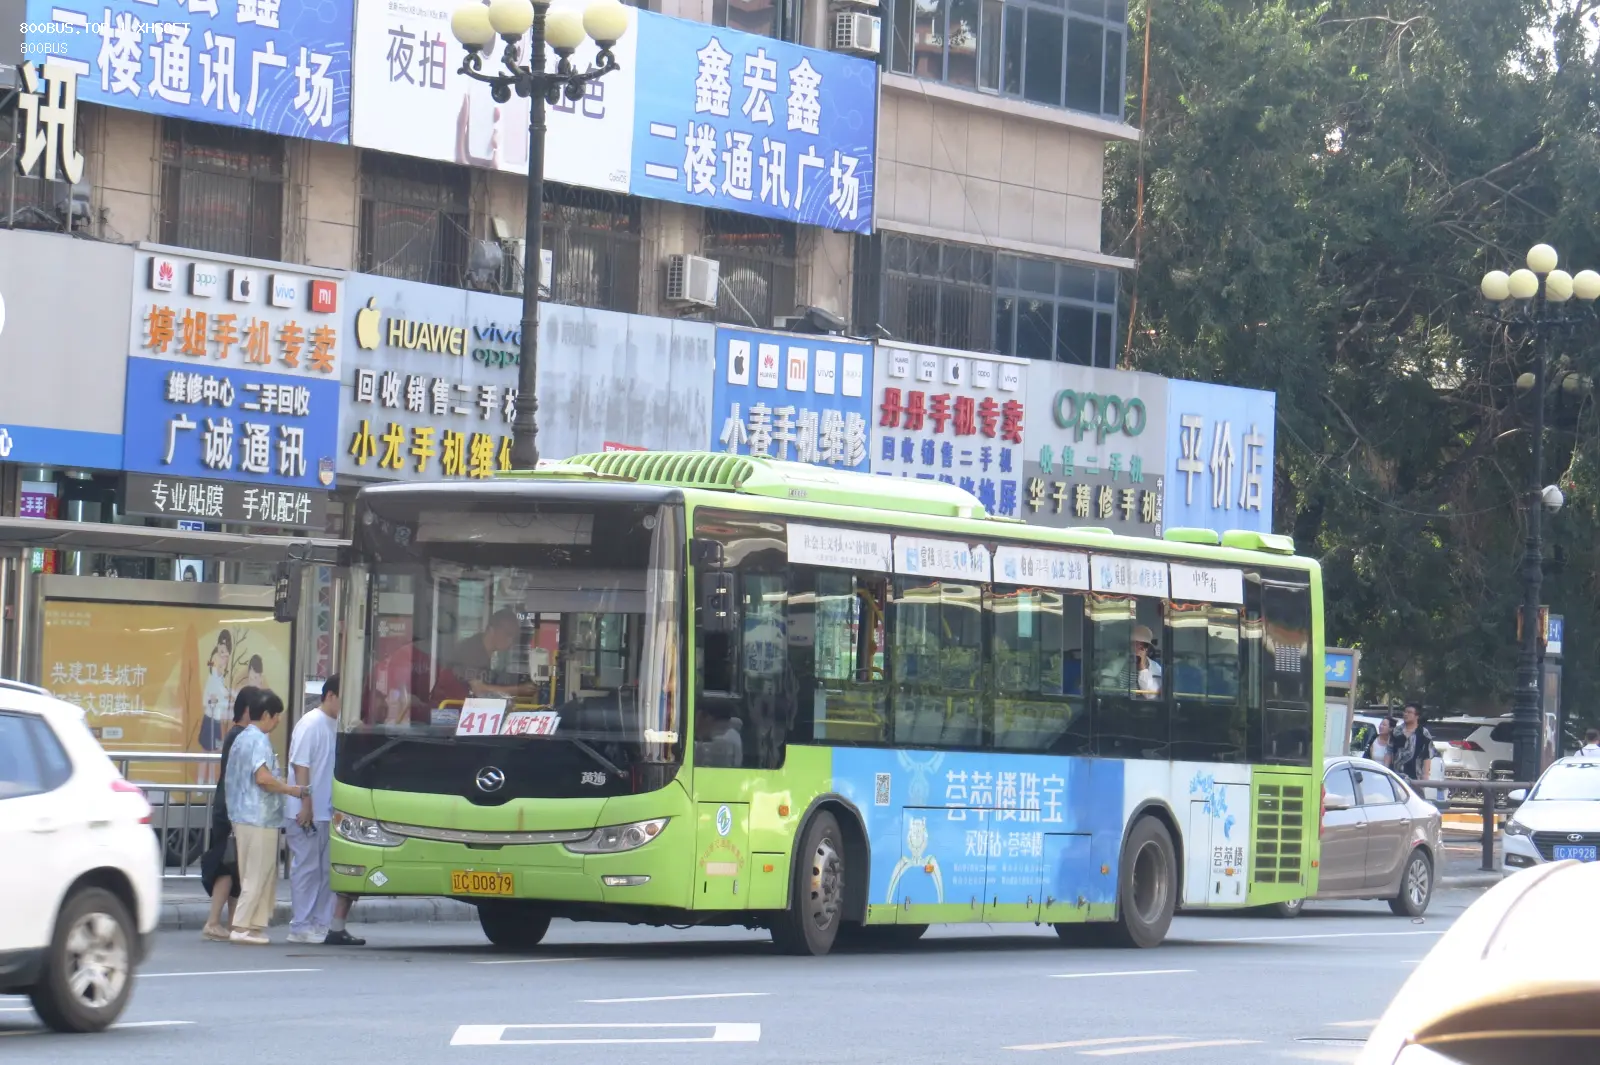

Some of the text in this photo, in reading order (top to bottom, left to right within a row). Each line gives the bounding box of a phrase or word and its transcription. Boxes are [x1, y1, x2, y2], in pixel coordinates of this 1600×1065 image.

[46, 7, 335, 127] 二楼通讯广场
[386, 24, 447, 90] 夜拍
[695, 36, 823, 135] 鑫宏鑫
[18, 60, 84, 185] 讯
[645, 120, 860, 220] 二楼通讯广场
[275, 285, 296, 300] vivo
[145, 303, 337, 374] 婷姐手机专卖
[387, 317, 468, 356] HUAWEI
[166, 371, 311, 417] 维修中心 二手回收
[880, 387, 1024, 444] 丹丹手机专卖
[163, 412, 307, 477] 广诚通讯
[719, 401, 867, 467] 小春手机维修
[1177, 413, 1266, 512] 平价店
[151, 479, 312, 524] 专业贴膜 手机配件
[1029, 476, 1157, 524] 华子精修手机
[51, 661, 148, 687] 共建卫生城市
[459, 712, 550, 735] 411 火炬广场
[580, 771, 606, 786] 黄海
[945, 770, 1064, 823] 荟萃楼珠宝
